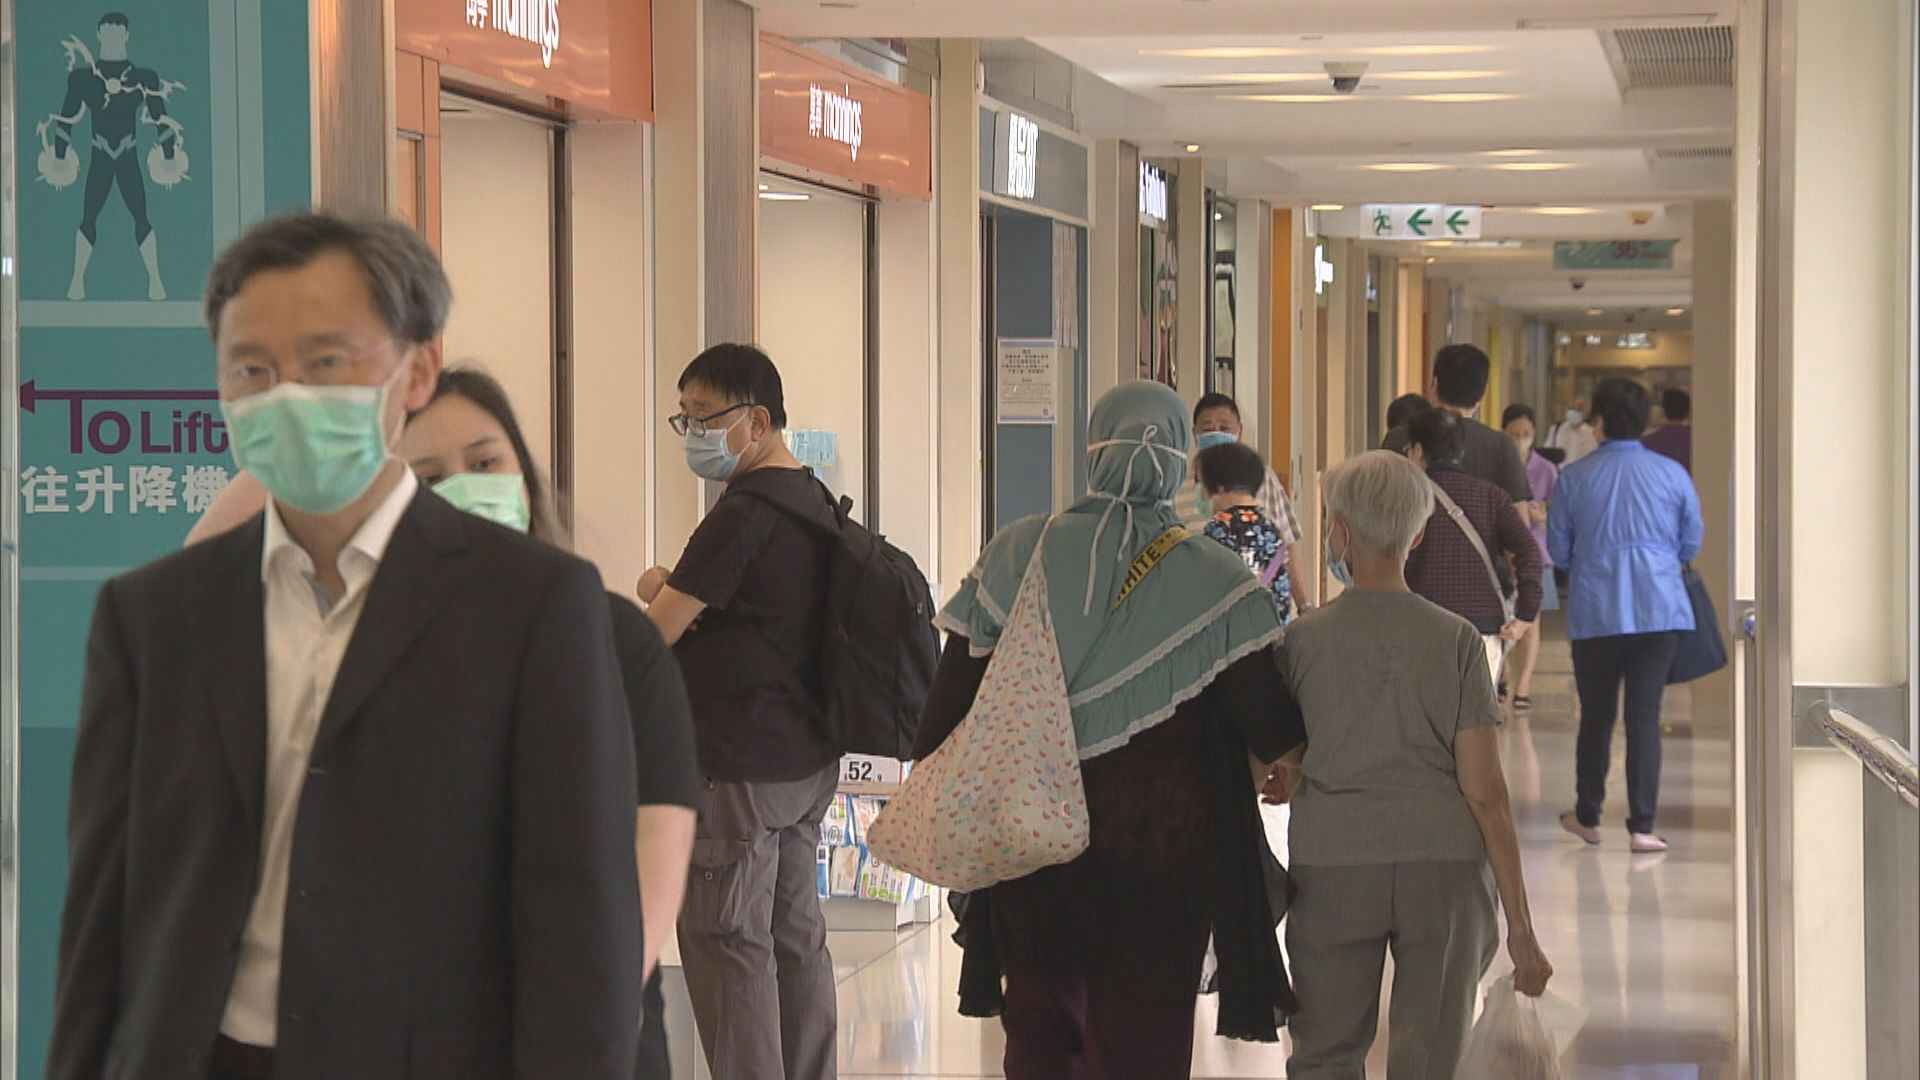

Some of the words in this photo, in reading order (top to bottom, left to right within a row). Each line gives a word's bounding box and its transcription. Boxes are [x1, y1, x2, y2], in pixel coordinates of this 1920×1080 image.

[824, 82, 862, 163] mannings
[140, 410, 230, 454] Lift
[20, 464, 229, 514] 往升降機
